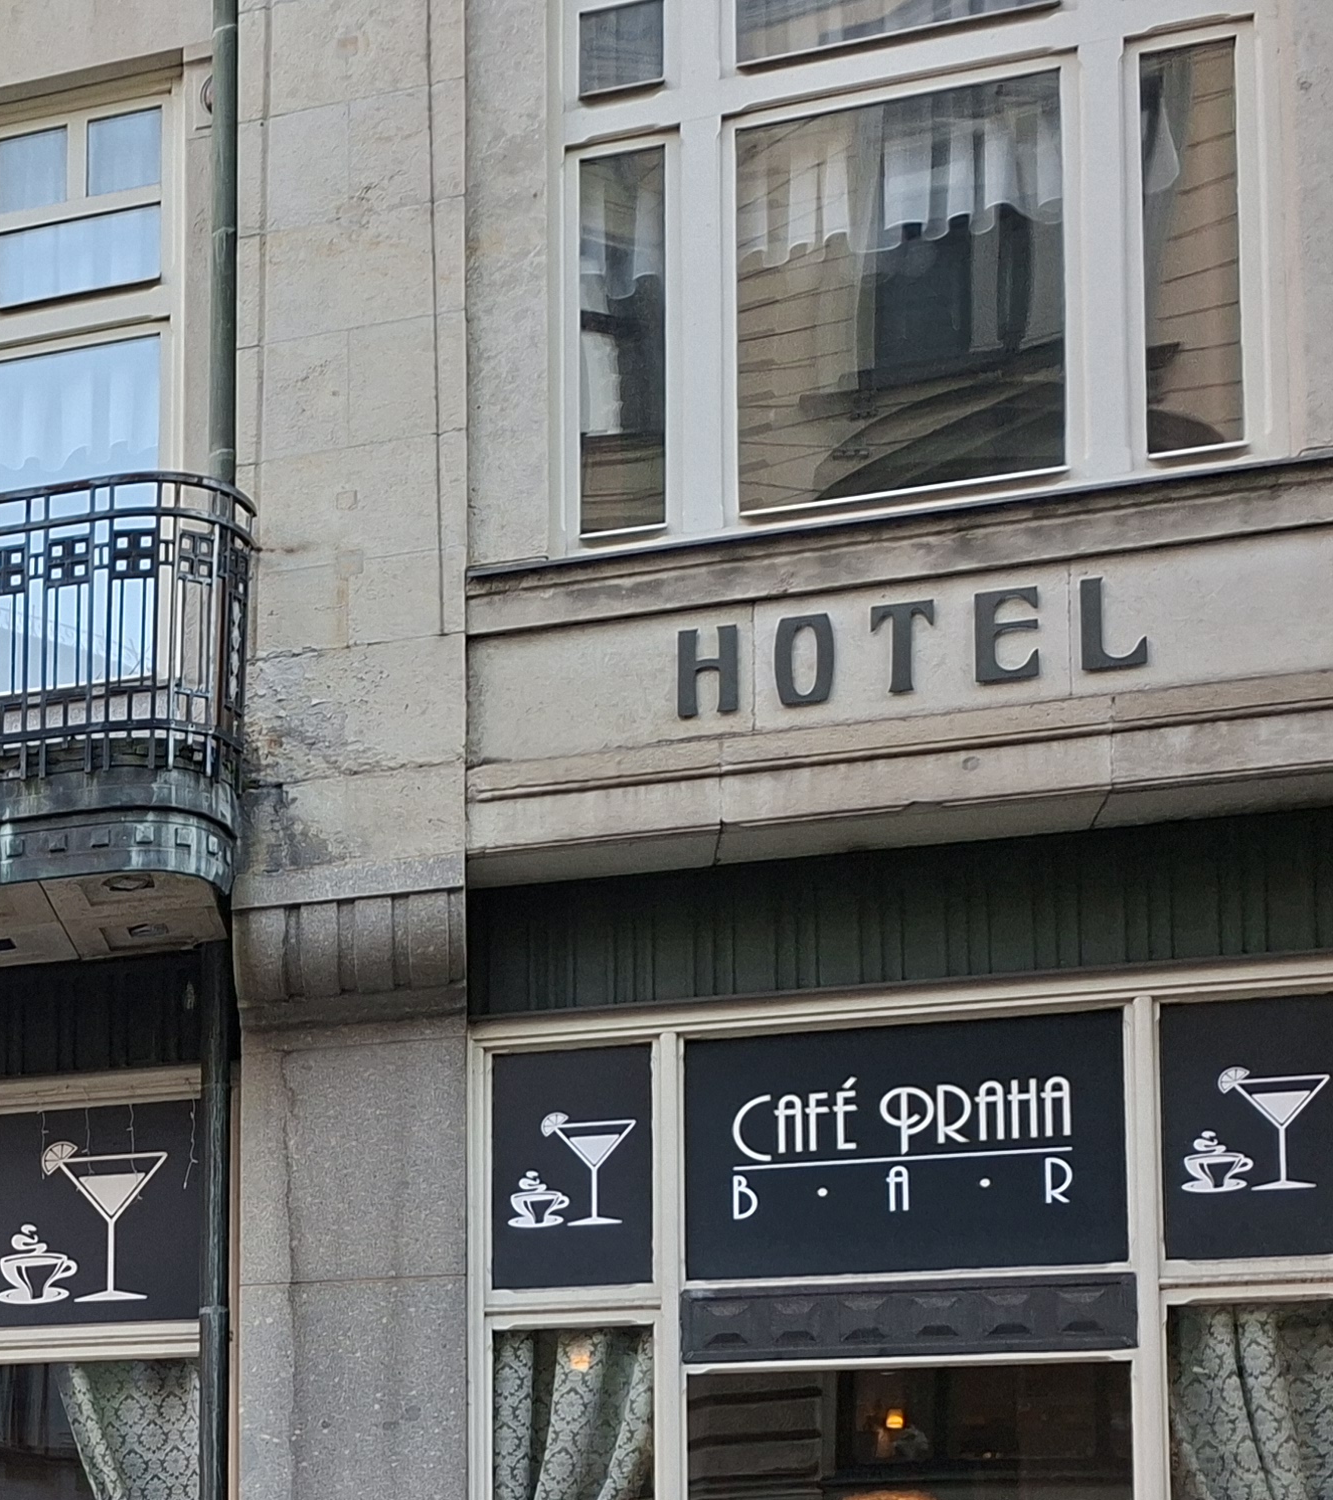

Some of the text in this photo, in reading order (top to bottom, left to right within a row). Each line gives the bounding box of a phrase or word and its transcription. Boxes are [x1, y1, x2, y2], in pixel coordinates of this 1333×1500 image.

[676, 576, 1149, 719] HOTEL
[731, 1075, 1072, 1162] CAFÉ PRAHA
